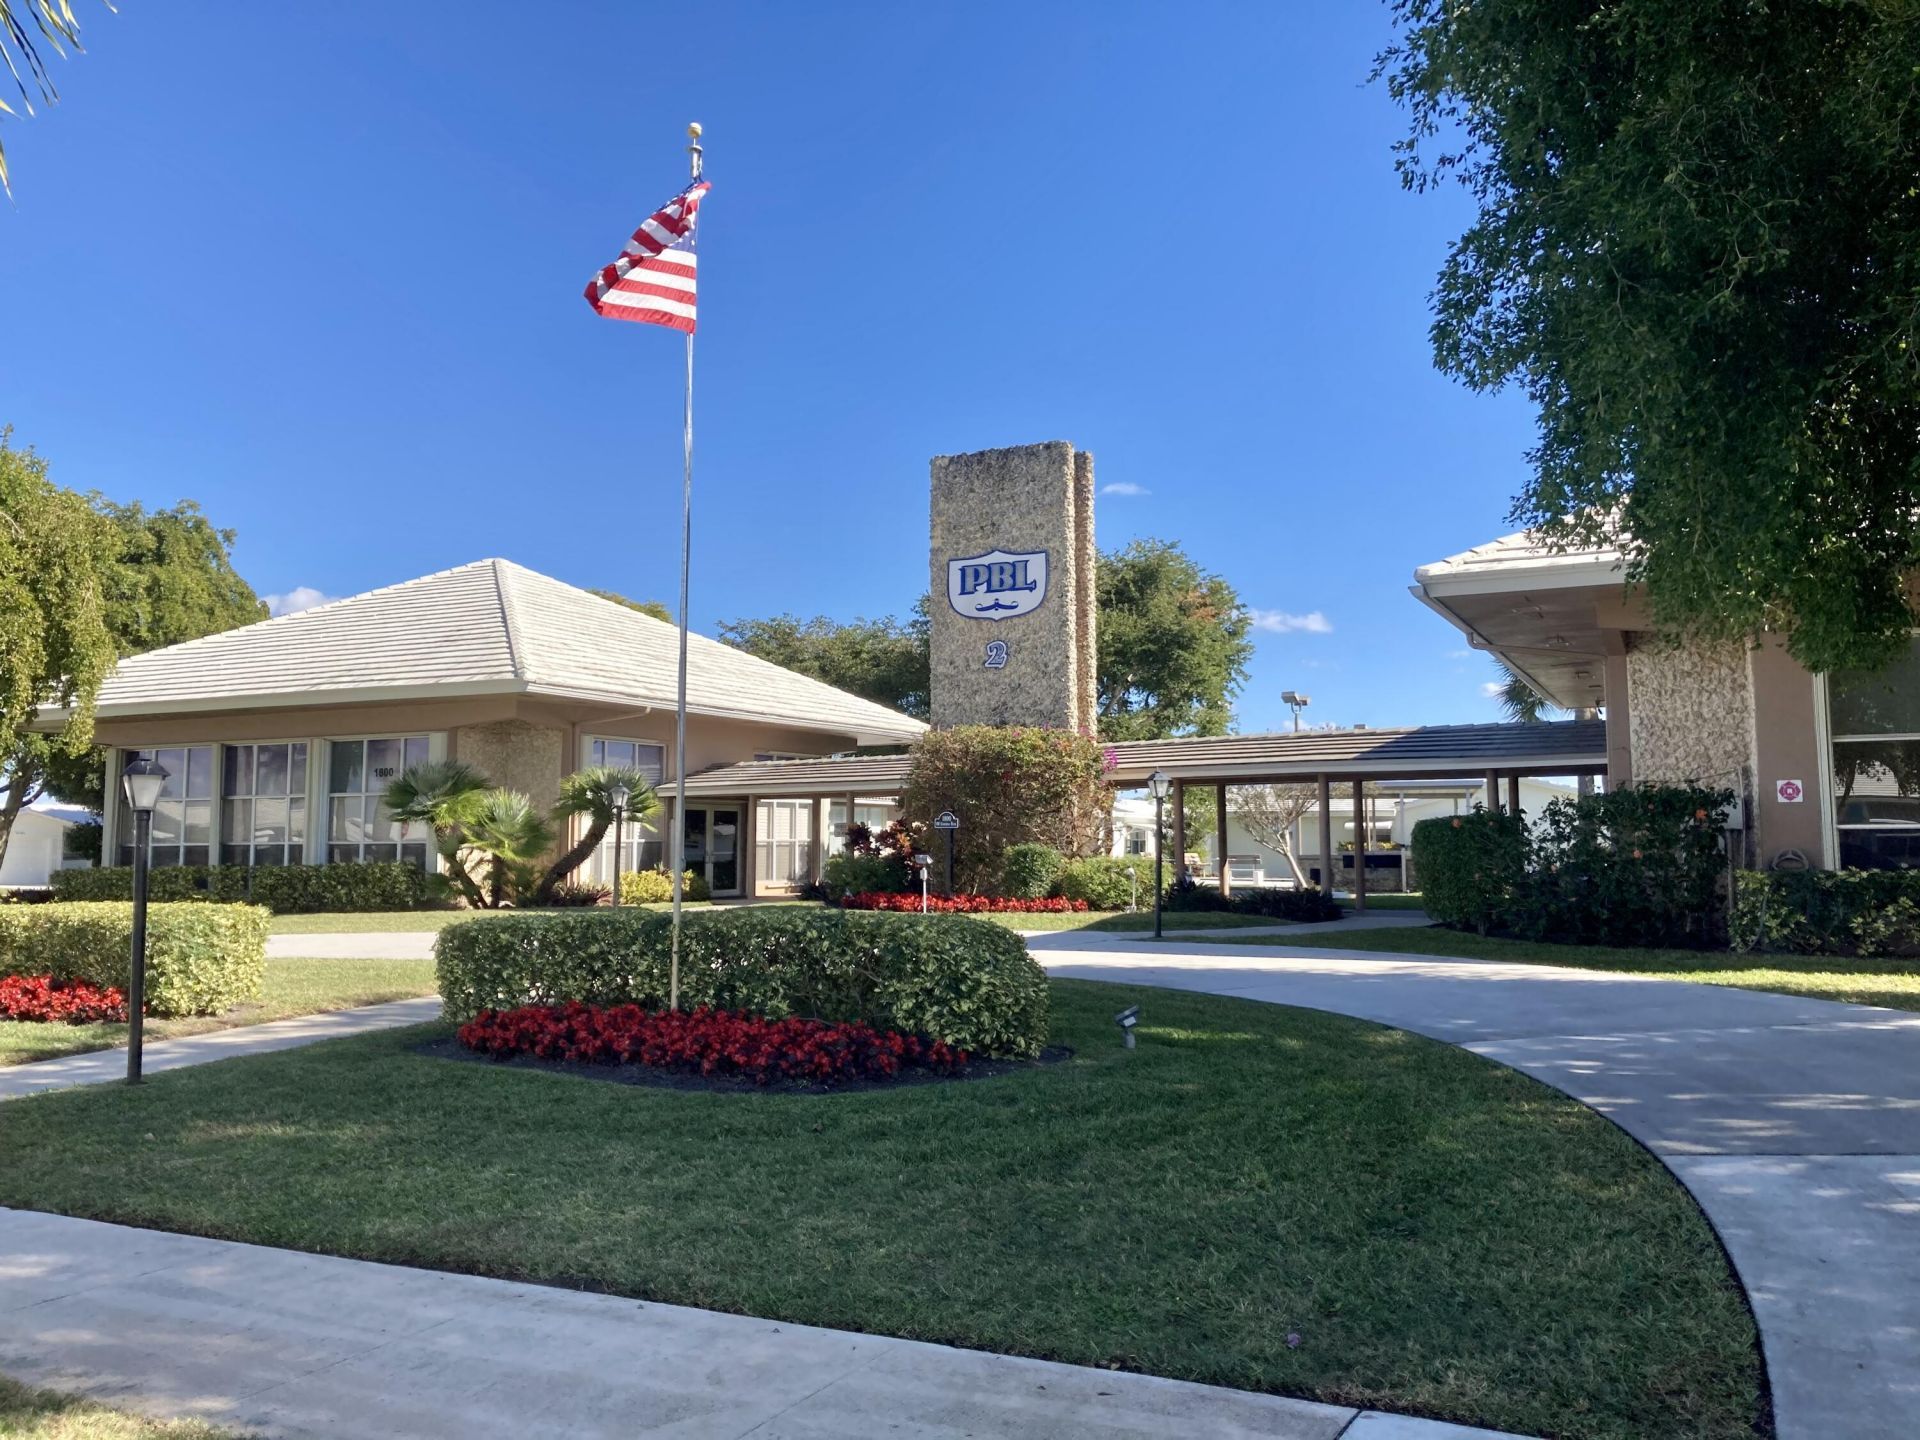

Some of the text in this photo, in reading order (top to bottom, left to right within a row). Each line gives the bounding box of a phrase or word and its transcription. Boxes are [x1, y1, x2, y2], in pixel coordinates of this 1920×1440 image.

[958, 560, 1037, 596] PBL
[984, 640, 1008, 669] 2
[374, 767, 394, 777] 1800
